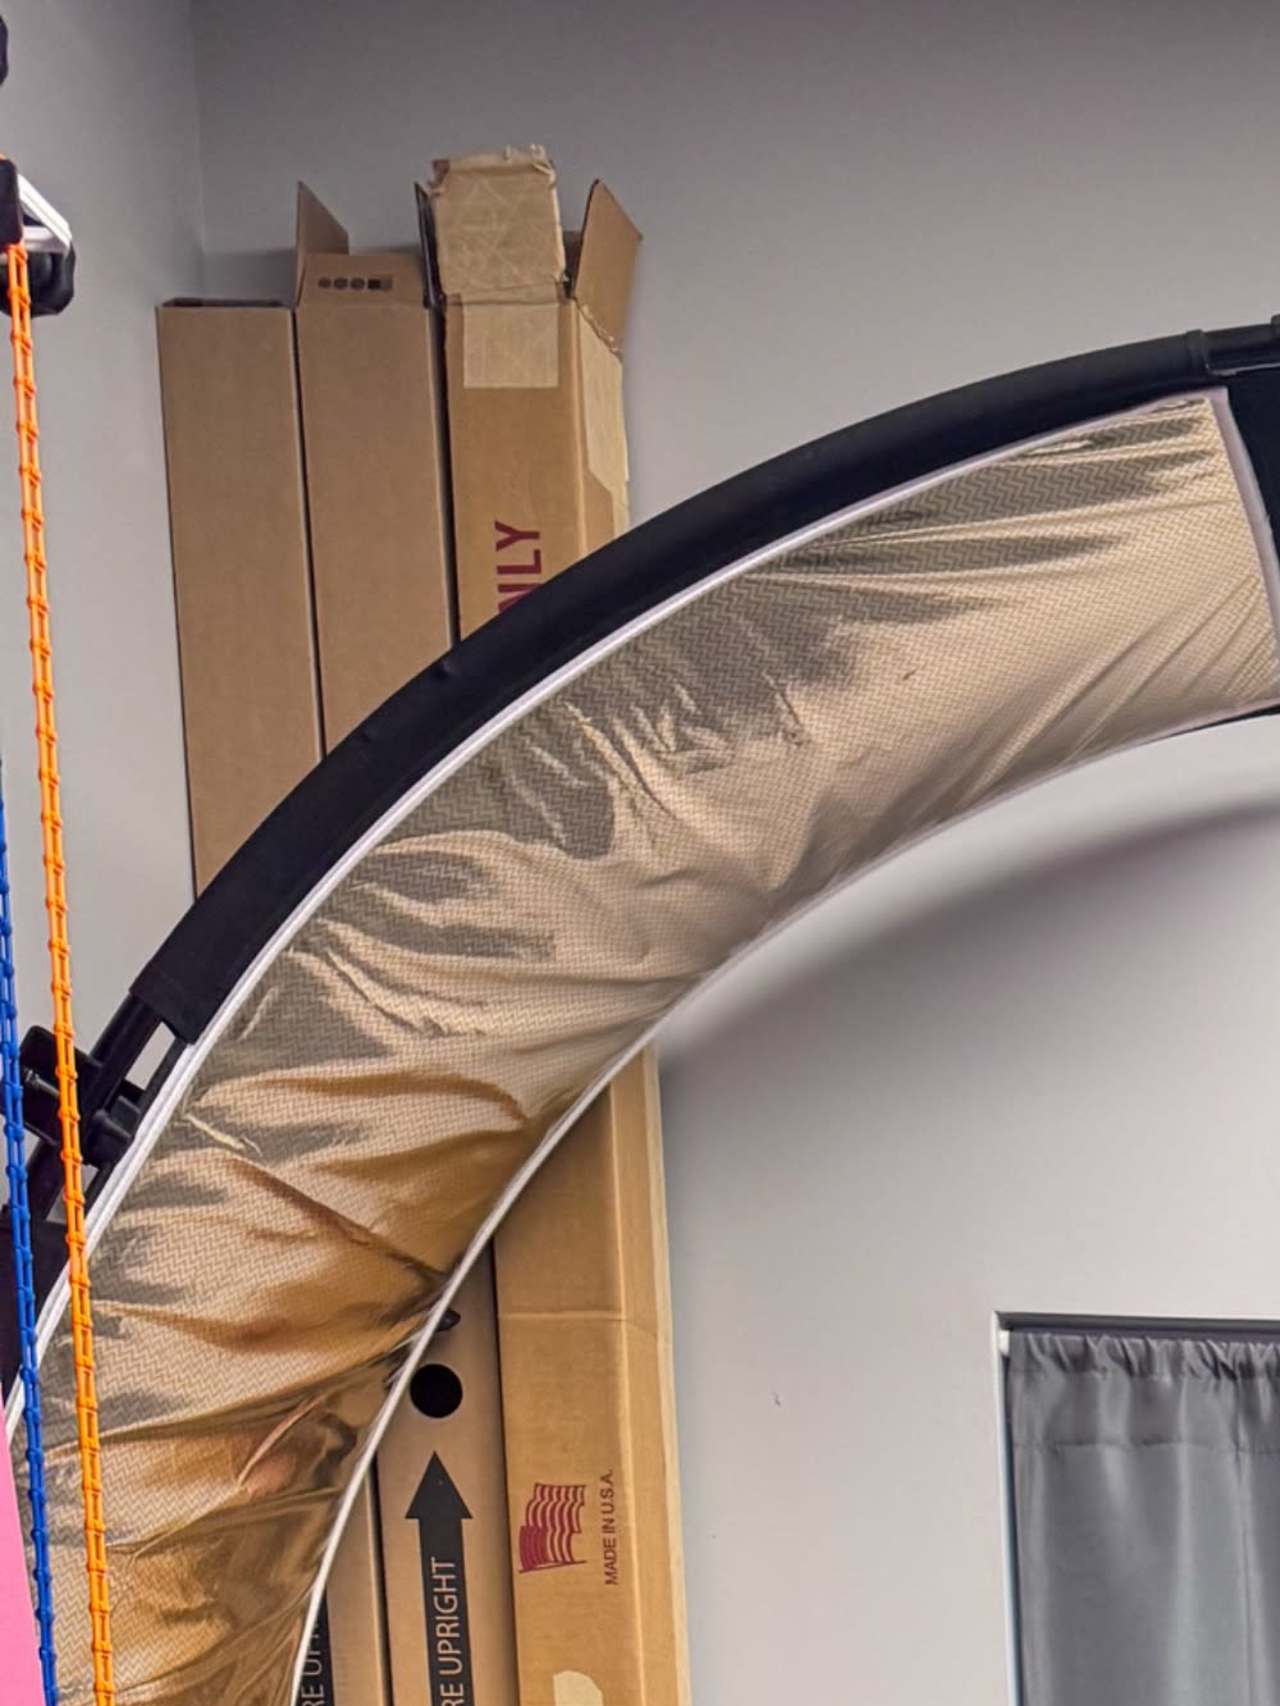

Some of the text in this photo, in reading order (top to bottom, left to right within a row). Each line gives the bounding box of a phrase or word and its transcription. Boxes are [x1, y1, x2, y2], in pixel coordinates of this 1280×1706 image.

[601, 1519, 615, 1534] IN
[603, 1538, 618, 1585] MADE
[431, 1556, 462, 1675] UPRIGHT
